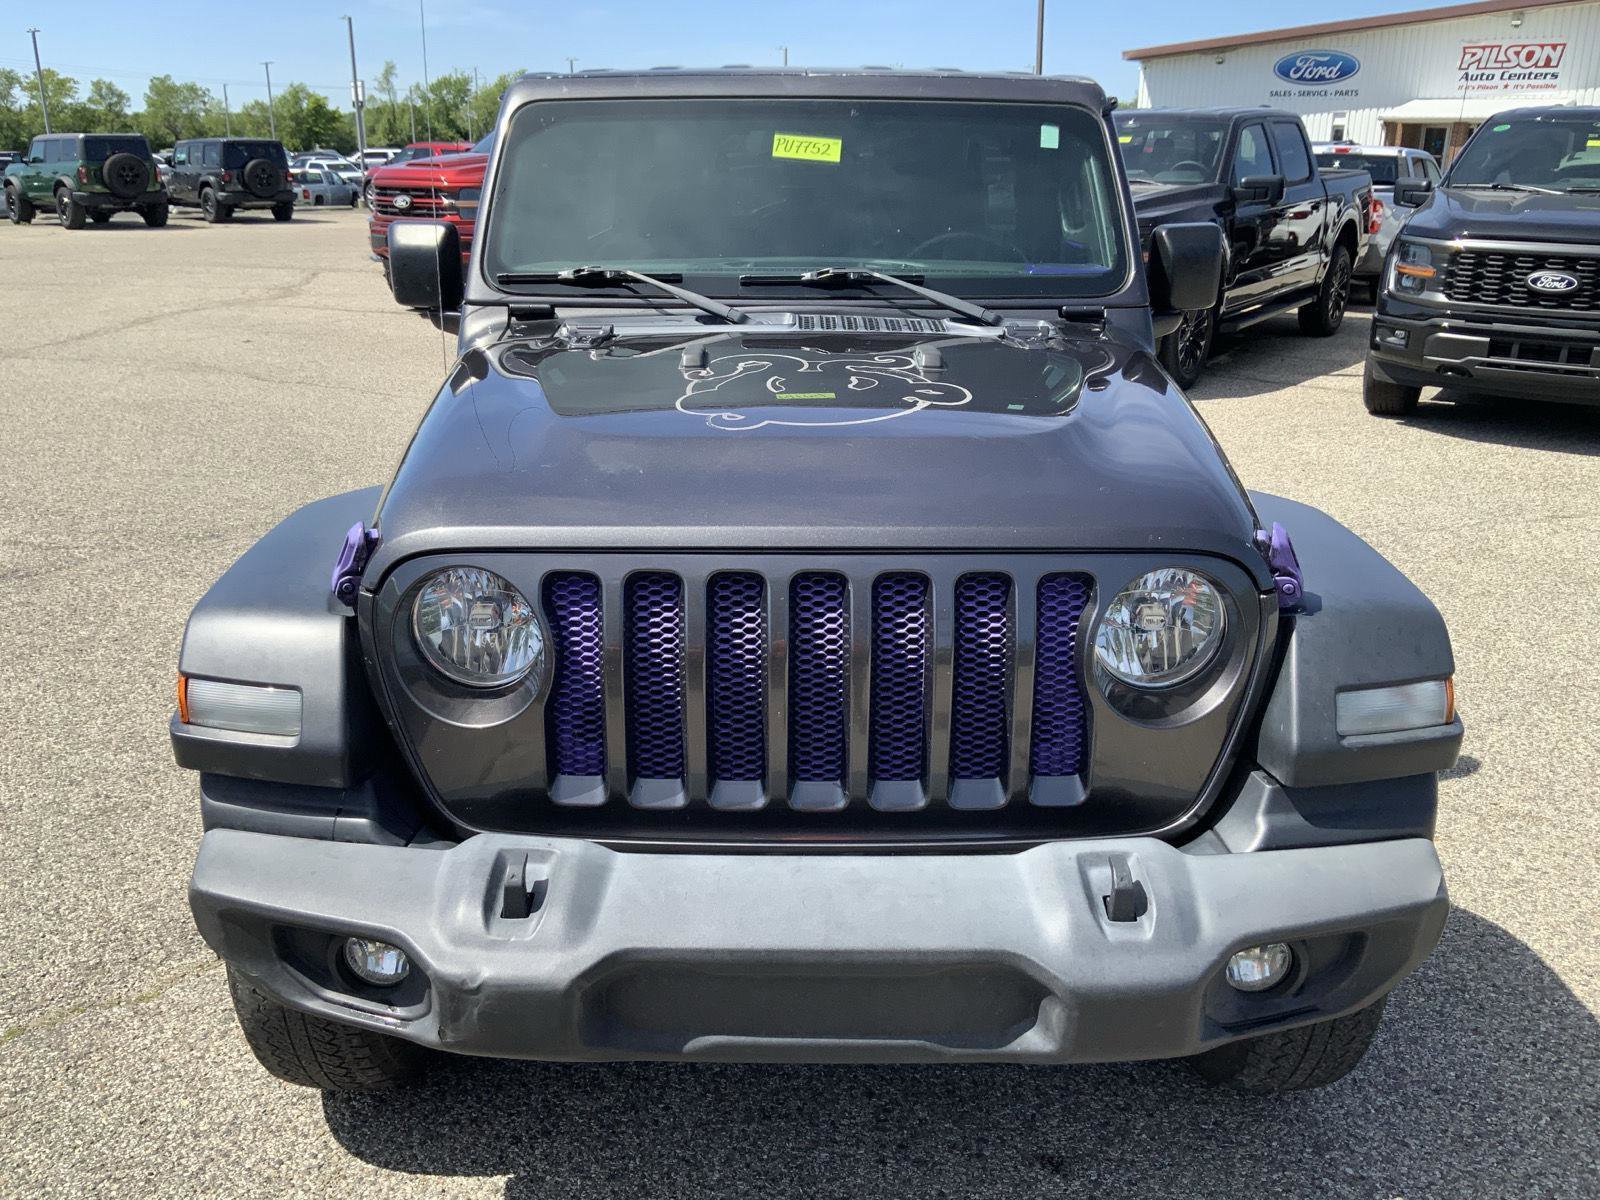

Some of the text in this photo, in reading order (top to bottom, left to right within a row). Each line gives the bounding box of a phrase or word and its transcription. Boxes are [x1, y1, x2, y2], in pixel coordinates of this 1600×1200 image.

[1458, 43, 1567, 70] PILSON
[1290, 55, 1343, 79] Ford
[1459, 71, 1559, 81] Auto Centers
[1271, 89, 1359, 97] SALES SERVICE PARTS
[1537, 276, 1568, 289] Ford
